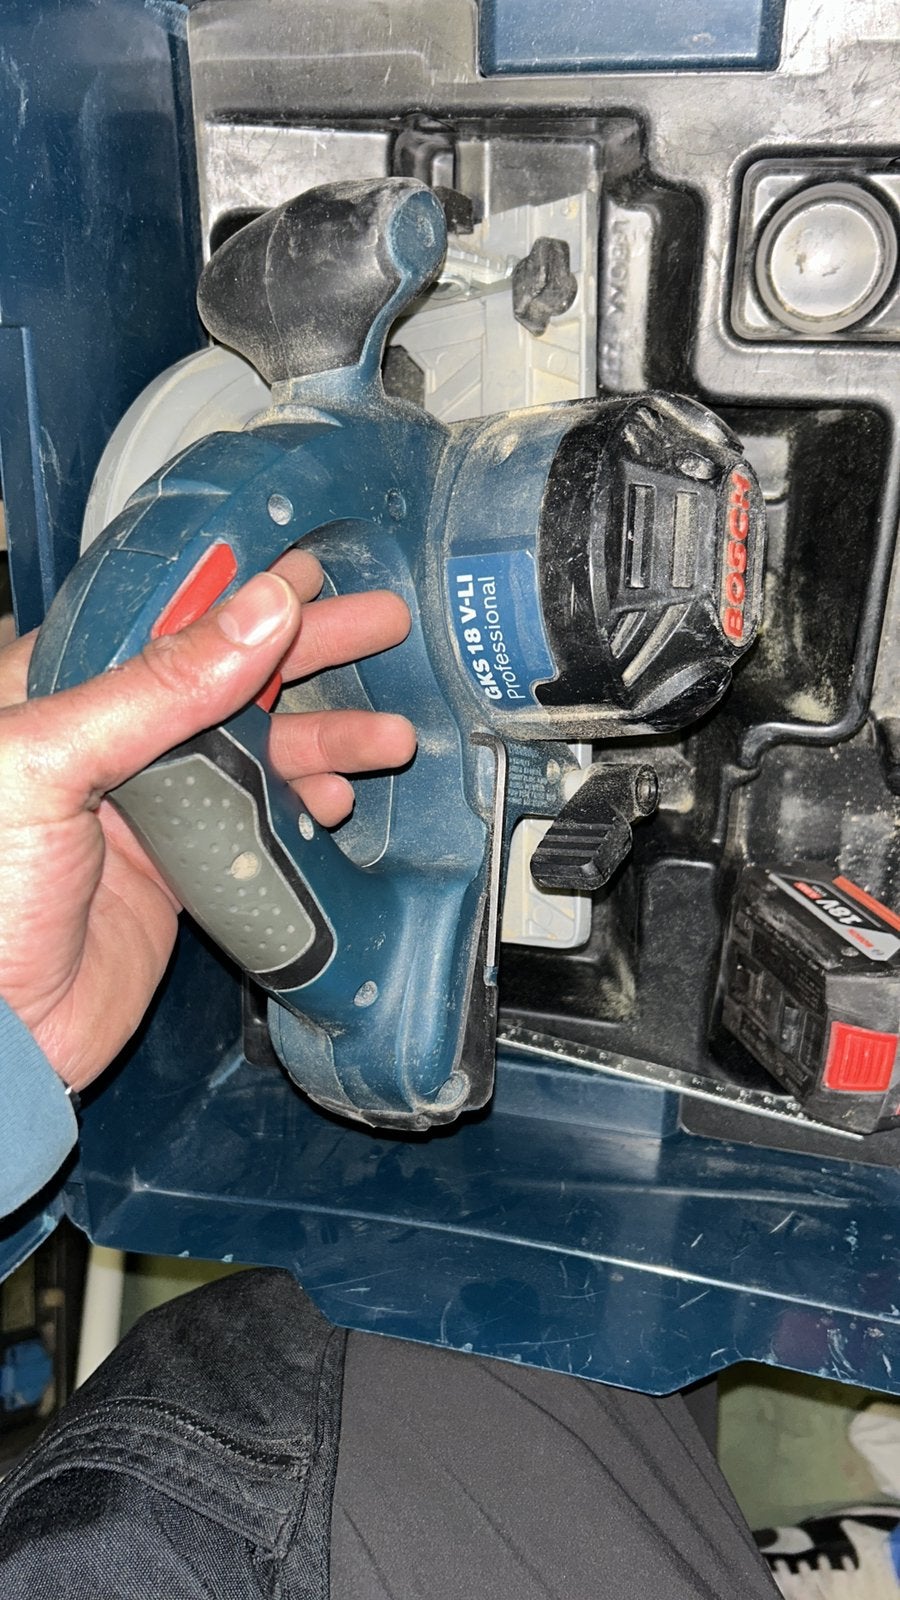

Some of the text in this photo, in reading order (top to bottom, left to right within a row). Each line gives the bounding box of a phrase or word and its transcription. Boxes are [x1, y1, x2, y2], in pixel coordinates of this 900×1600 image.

[723, 470, 751, 638] BOSCH
[456, 574, 503, 700] GKS 18 V-LI
[477, 576, 526, 699] Professional
[815, 899, 862, 924] 18V
